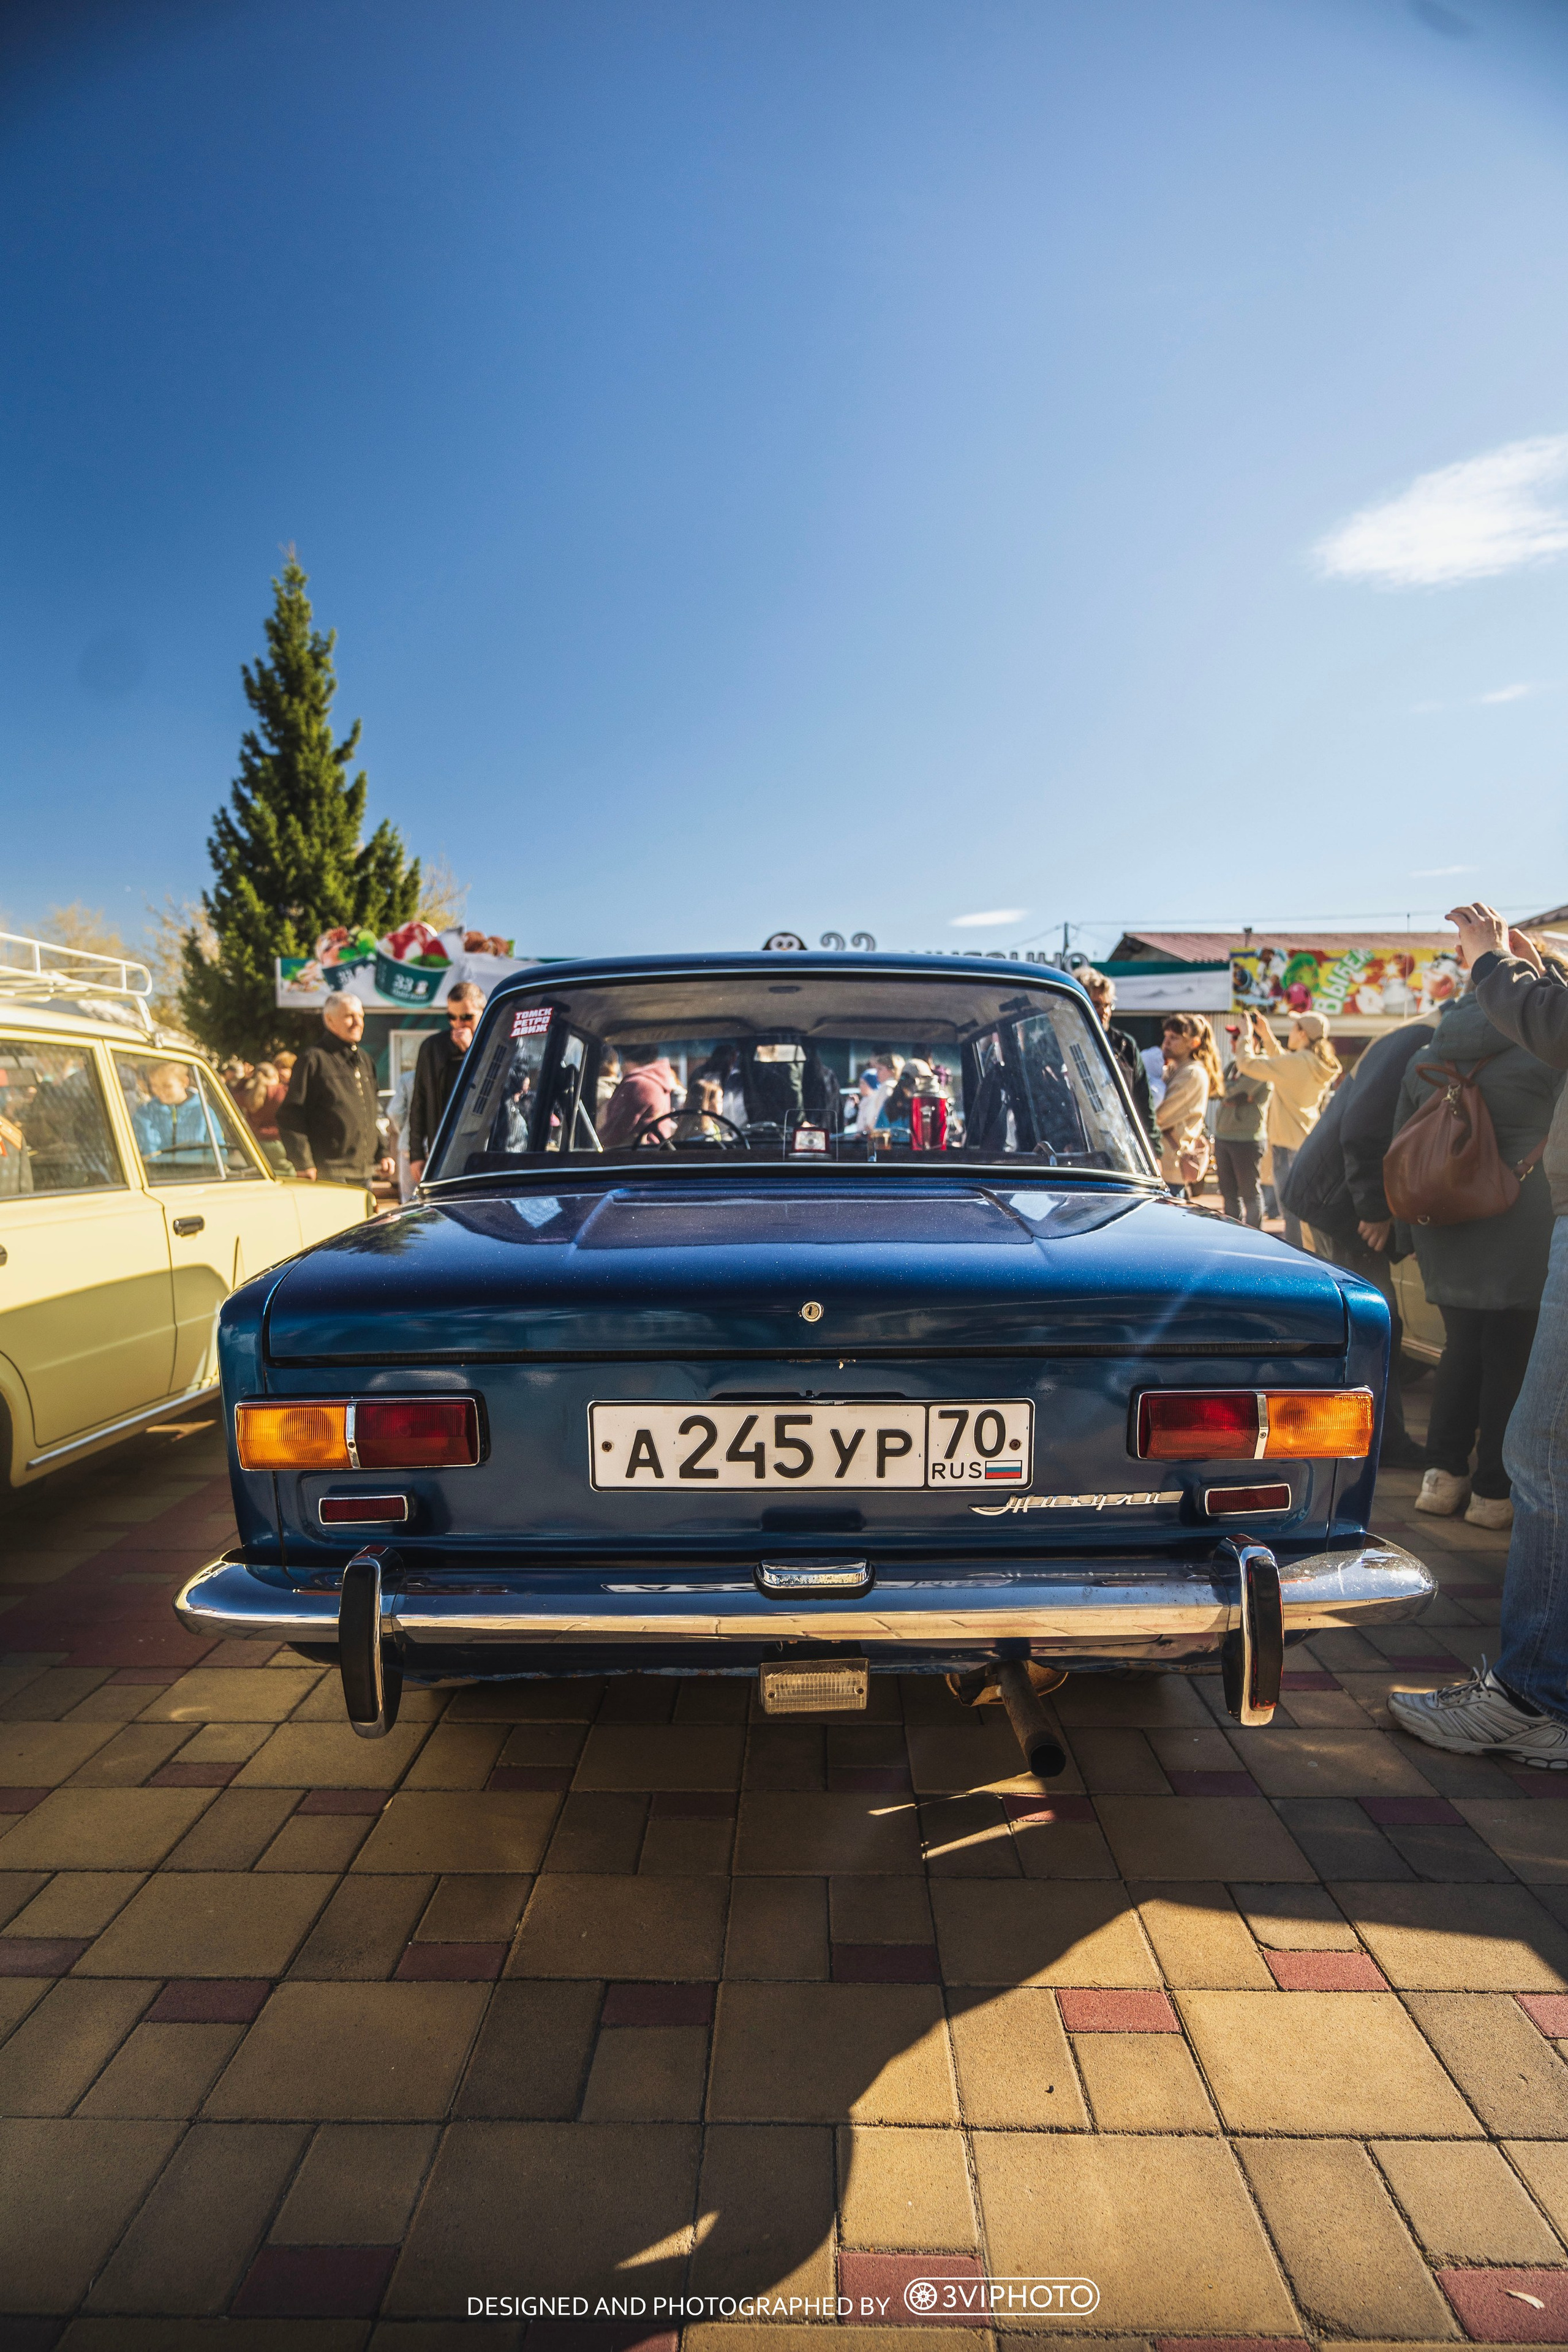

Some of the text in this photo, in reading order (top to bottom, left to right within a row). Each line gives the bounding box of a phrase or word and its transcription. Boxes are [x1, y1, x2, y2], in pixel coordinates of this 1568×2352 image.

[516, 1007, 552, 1020] ТОМСК
[513, 1016, 551, 1028] РЕТРО
[510, 1023, 548, 1037] ДВИЖ
[938, 1409, 1006, 1460] 70
[931, 1461, 982, 1480] RUS
